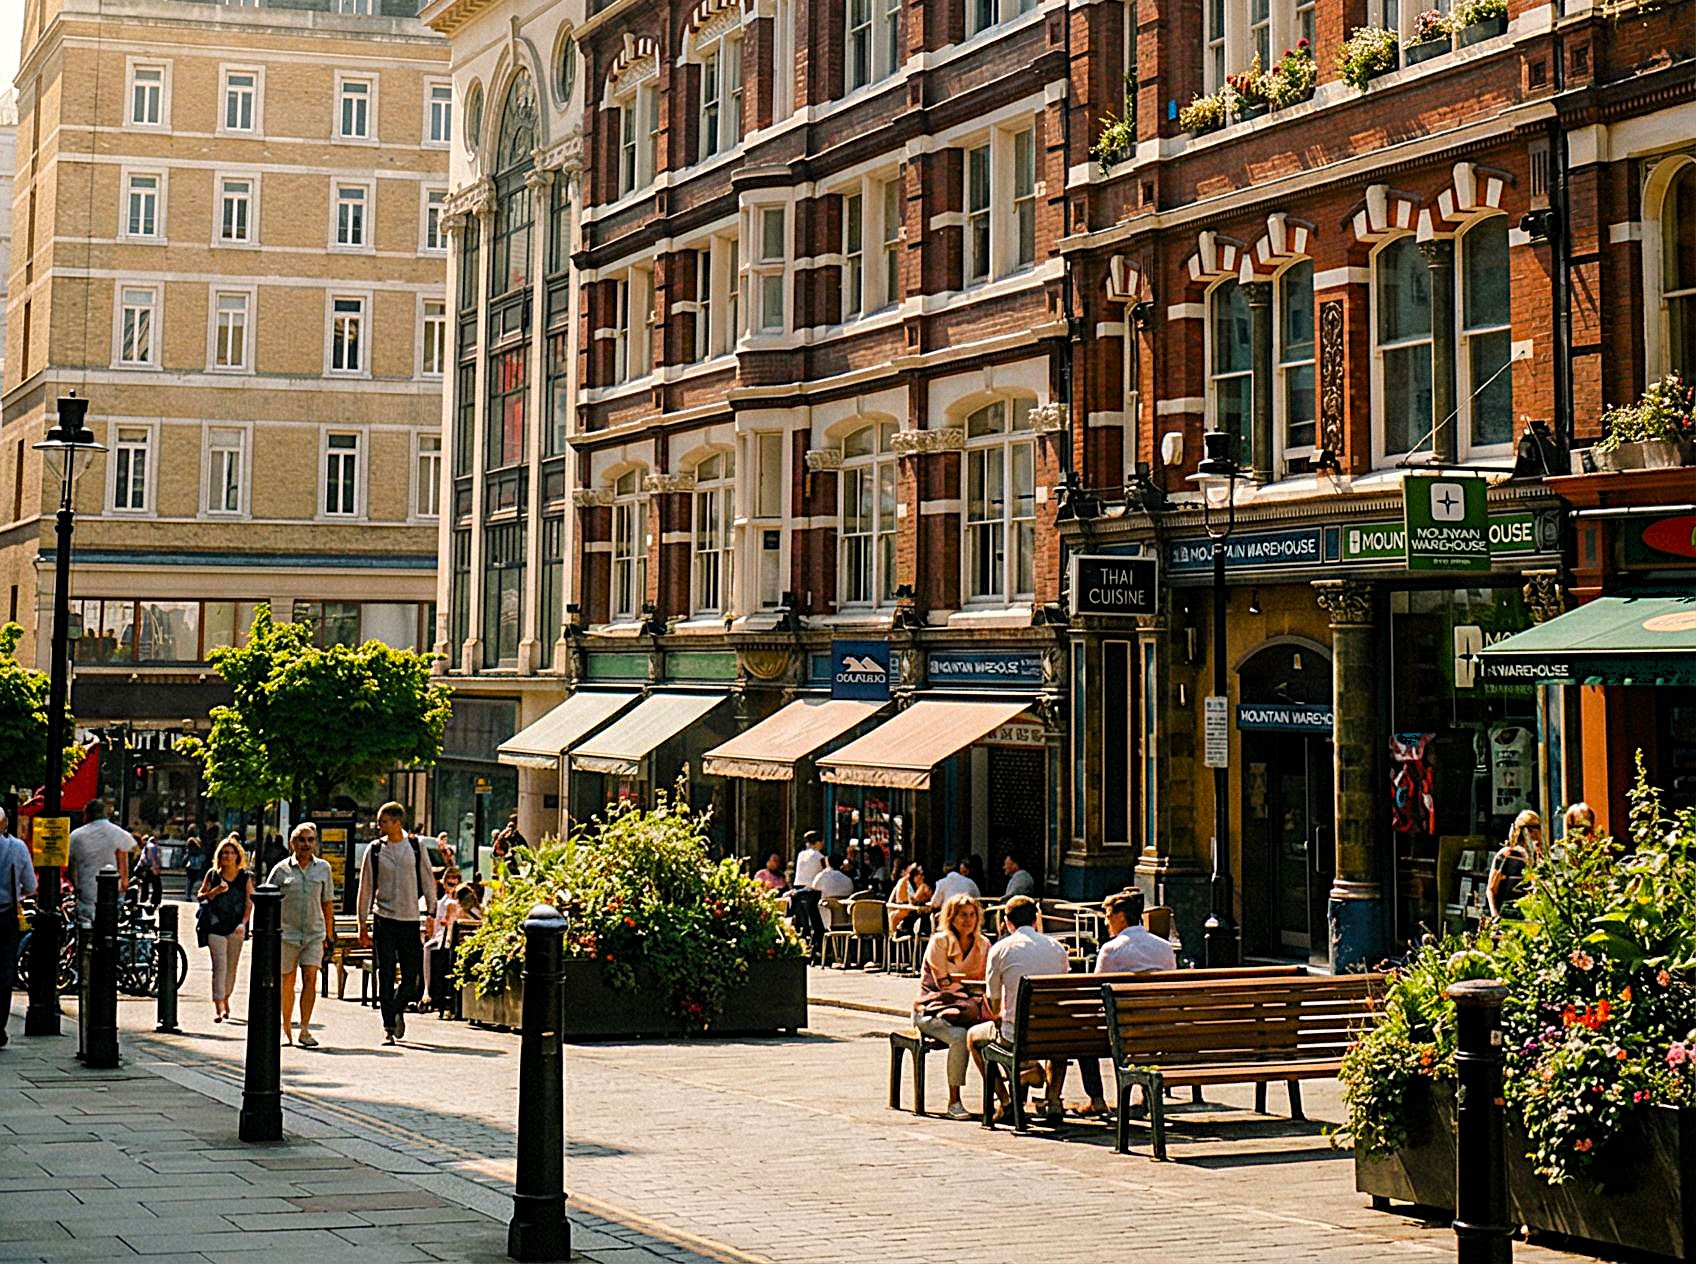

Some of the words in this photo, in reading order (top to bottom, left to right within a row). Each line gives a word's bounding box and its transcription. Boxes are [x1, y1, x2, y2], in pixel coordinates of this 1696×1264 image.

[1247, 538, 1316, 558] WAREHOUSE
[1362, 531, 1405, 550] MOUN
[1100, 568, 1133, 585] THAI
[1089, 588, 1146, 605] CUISINE
[1292, 711, 1333, 725] WAREHO
